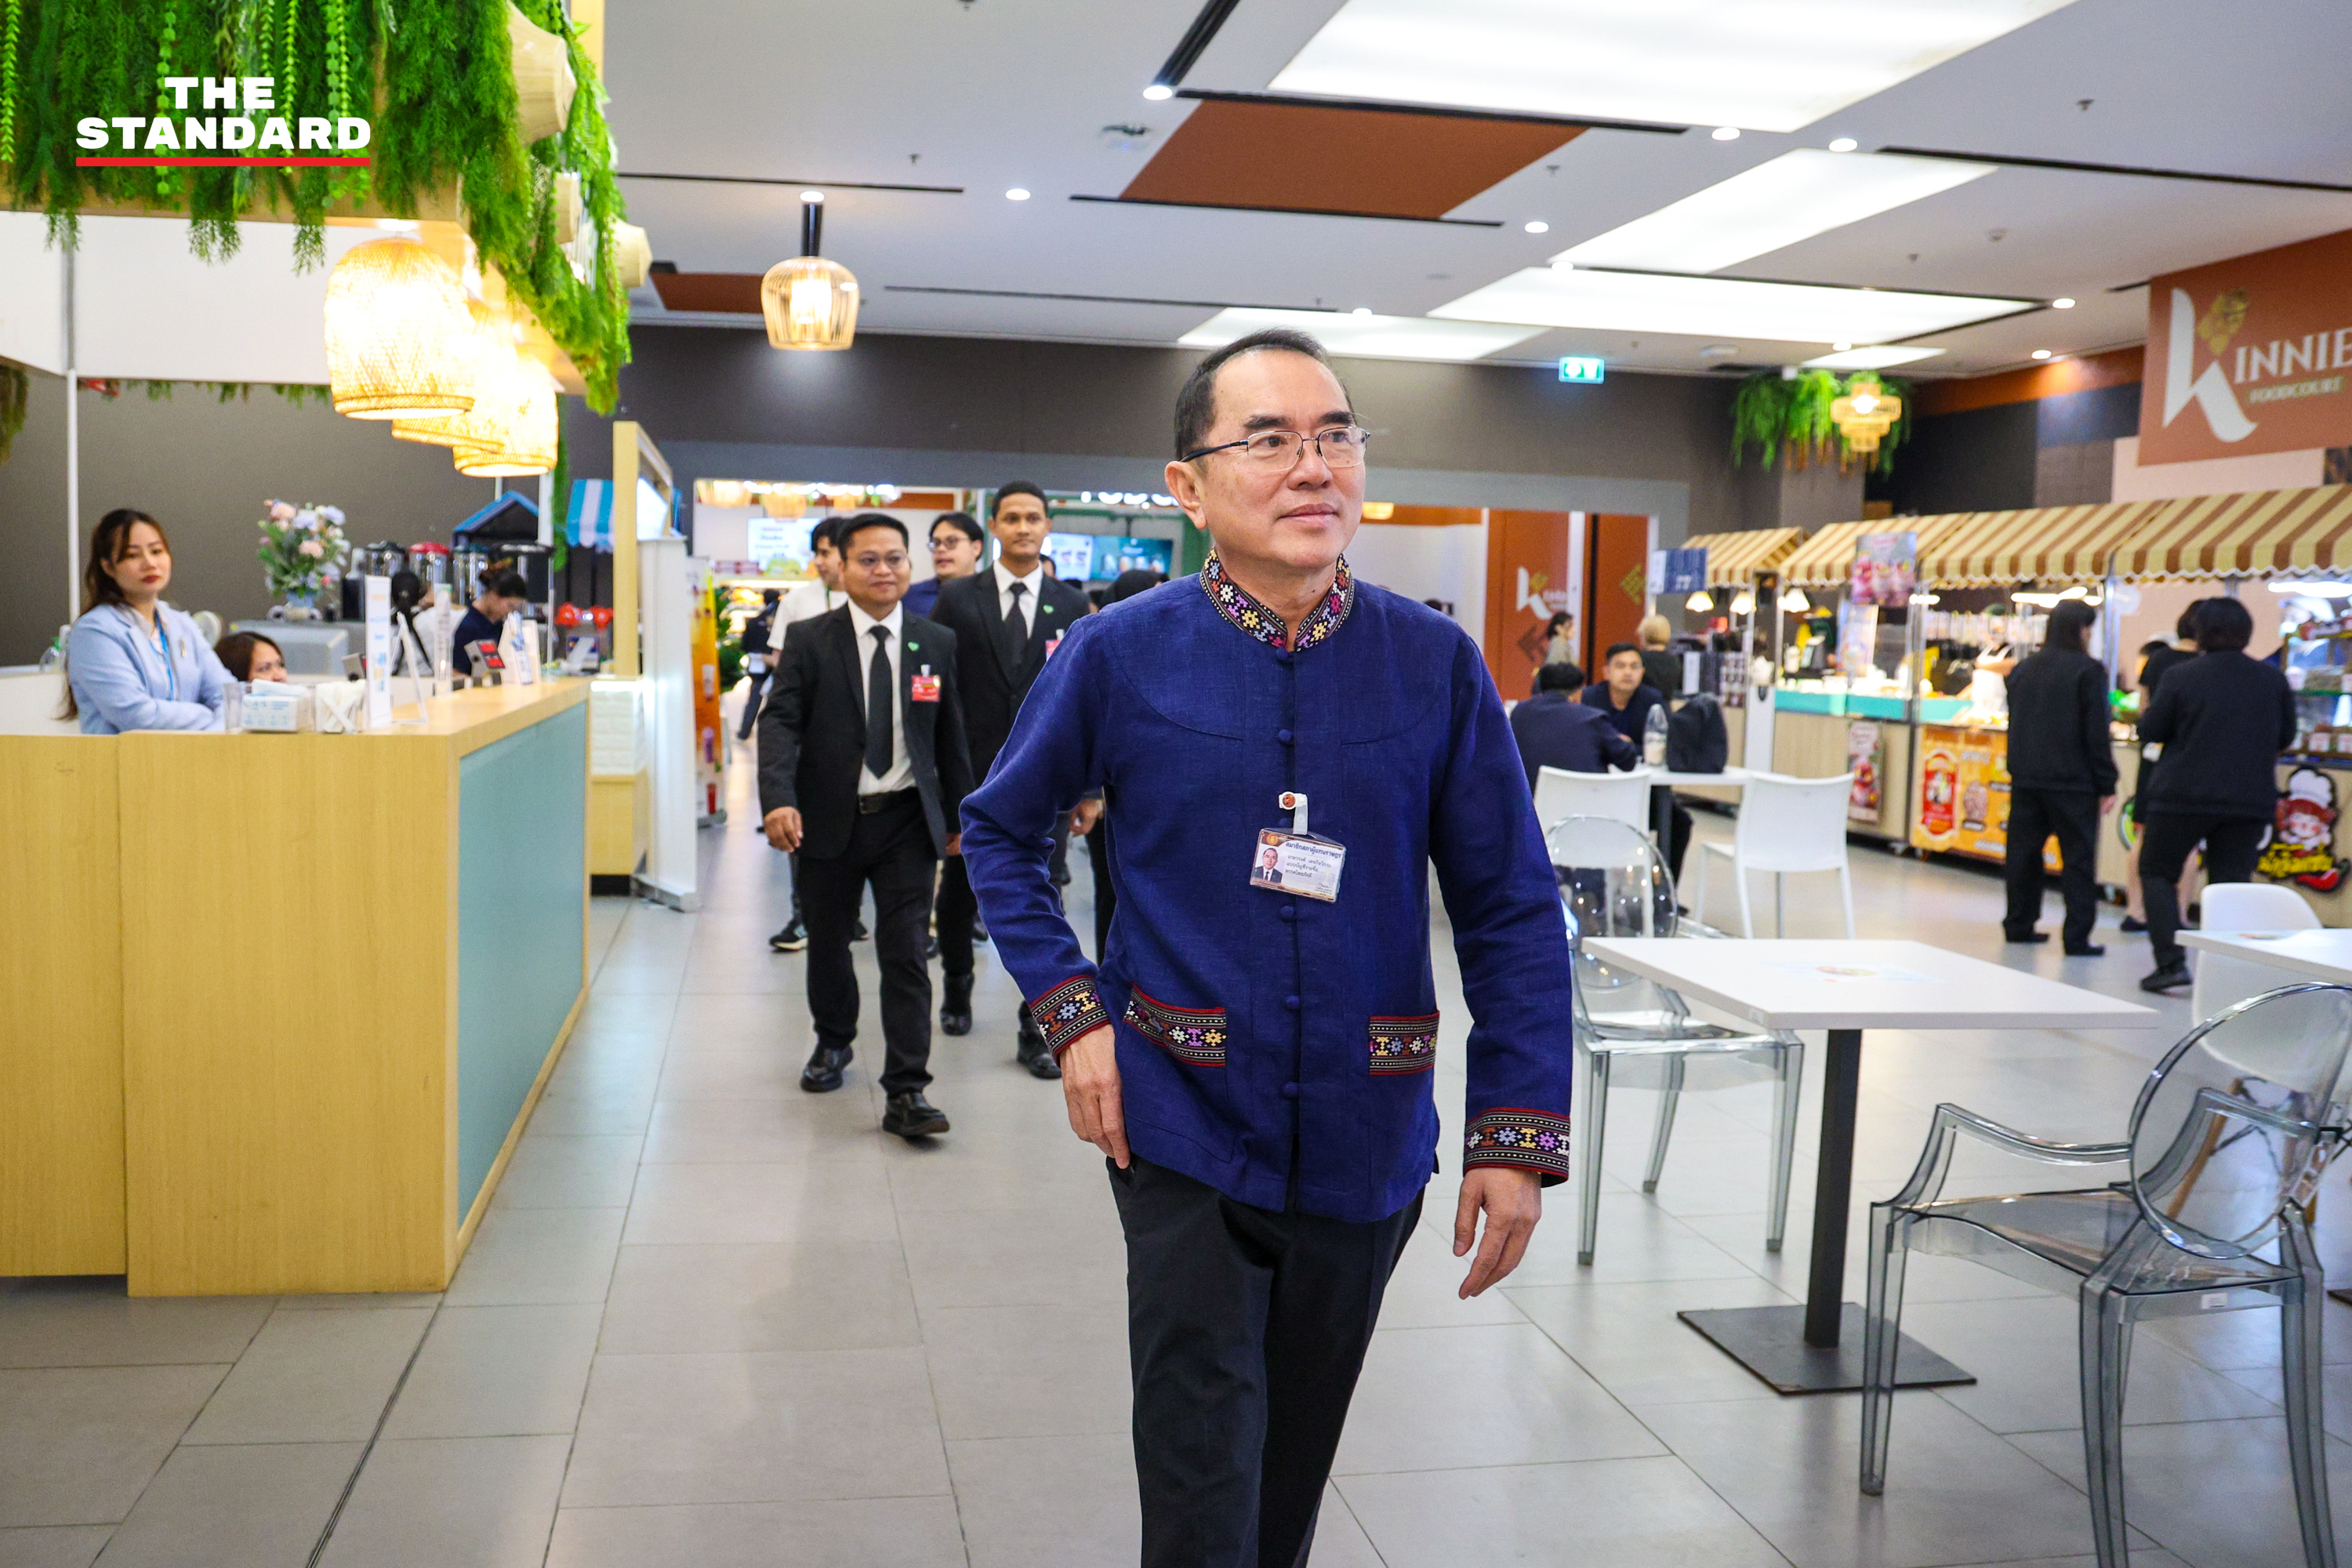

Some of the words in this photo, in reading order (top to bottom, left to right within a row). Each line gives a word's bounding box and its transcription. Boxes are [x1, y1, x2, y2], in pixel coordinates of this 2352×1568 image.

[1285, 841, 1341, 858] สมาชิกสภาผู้แทนราษฎร
